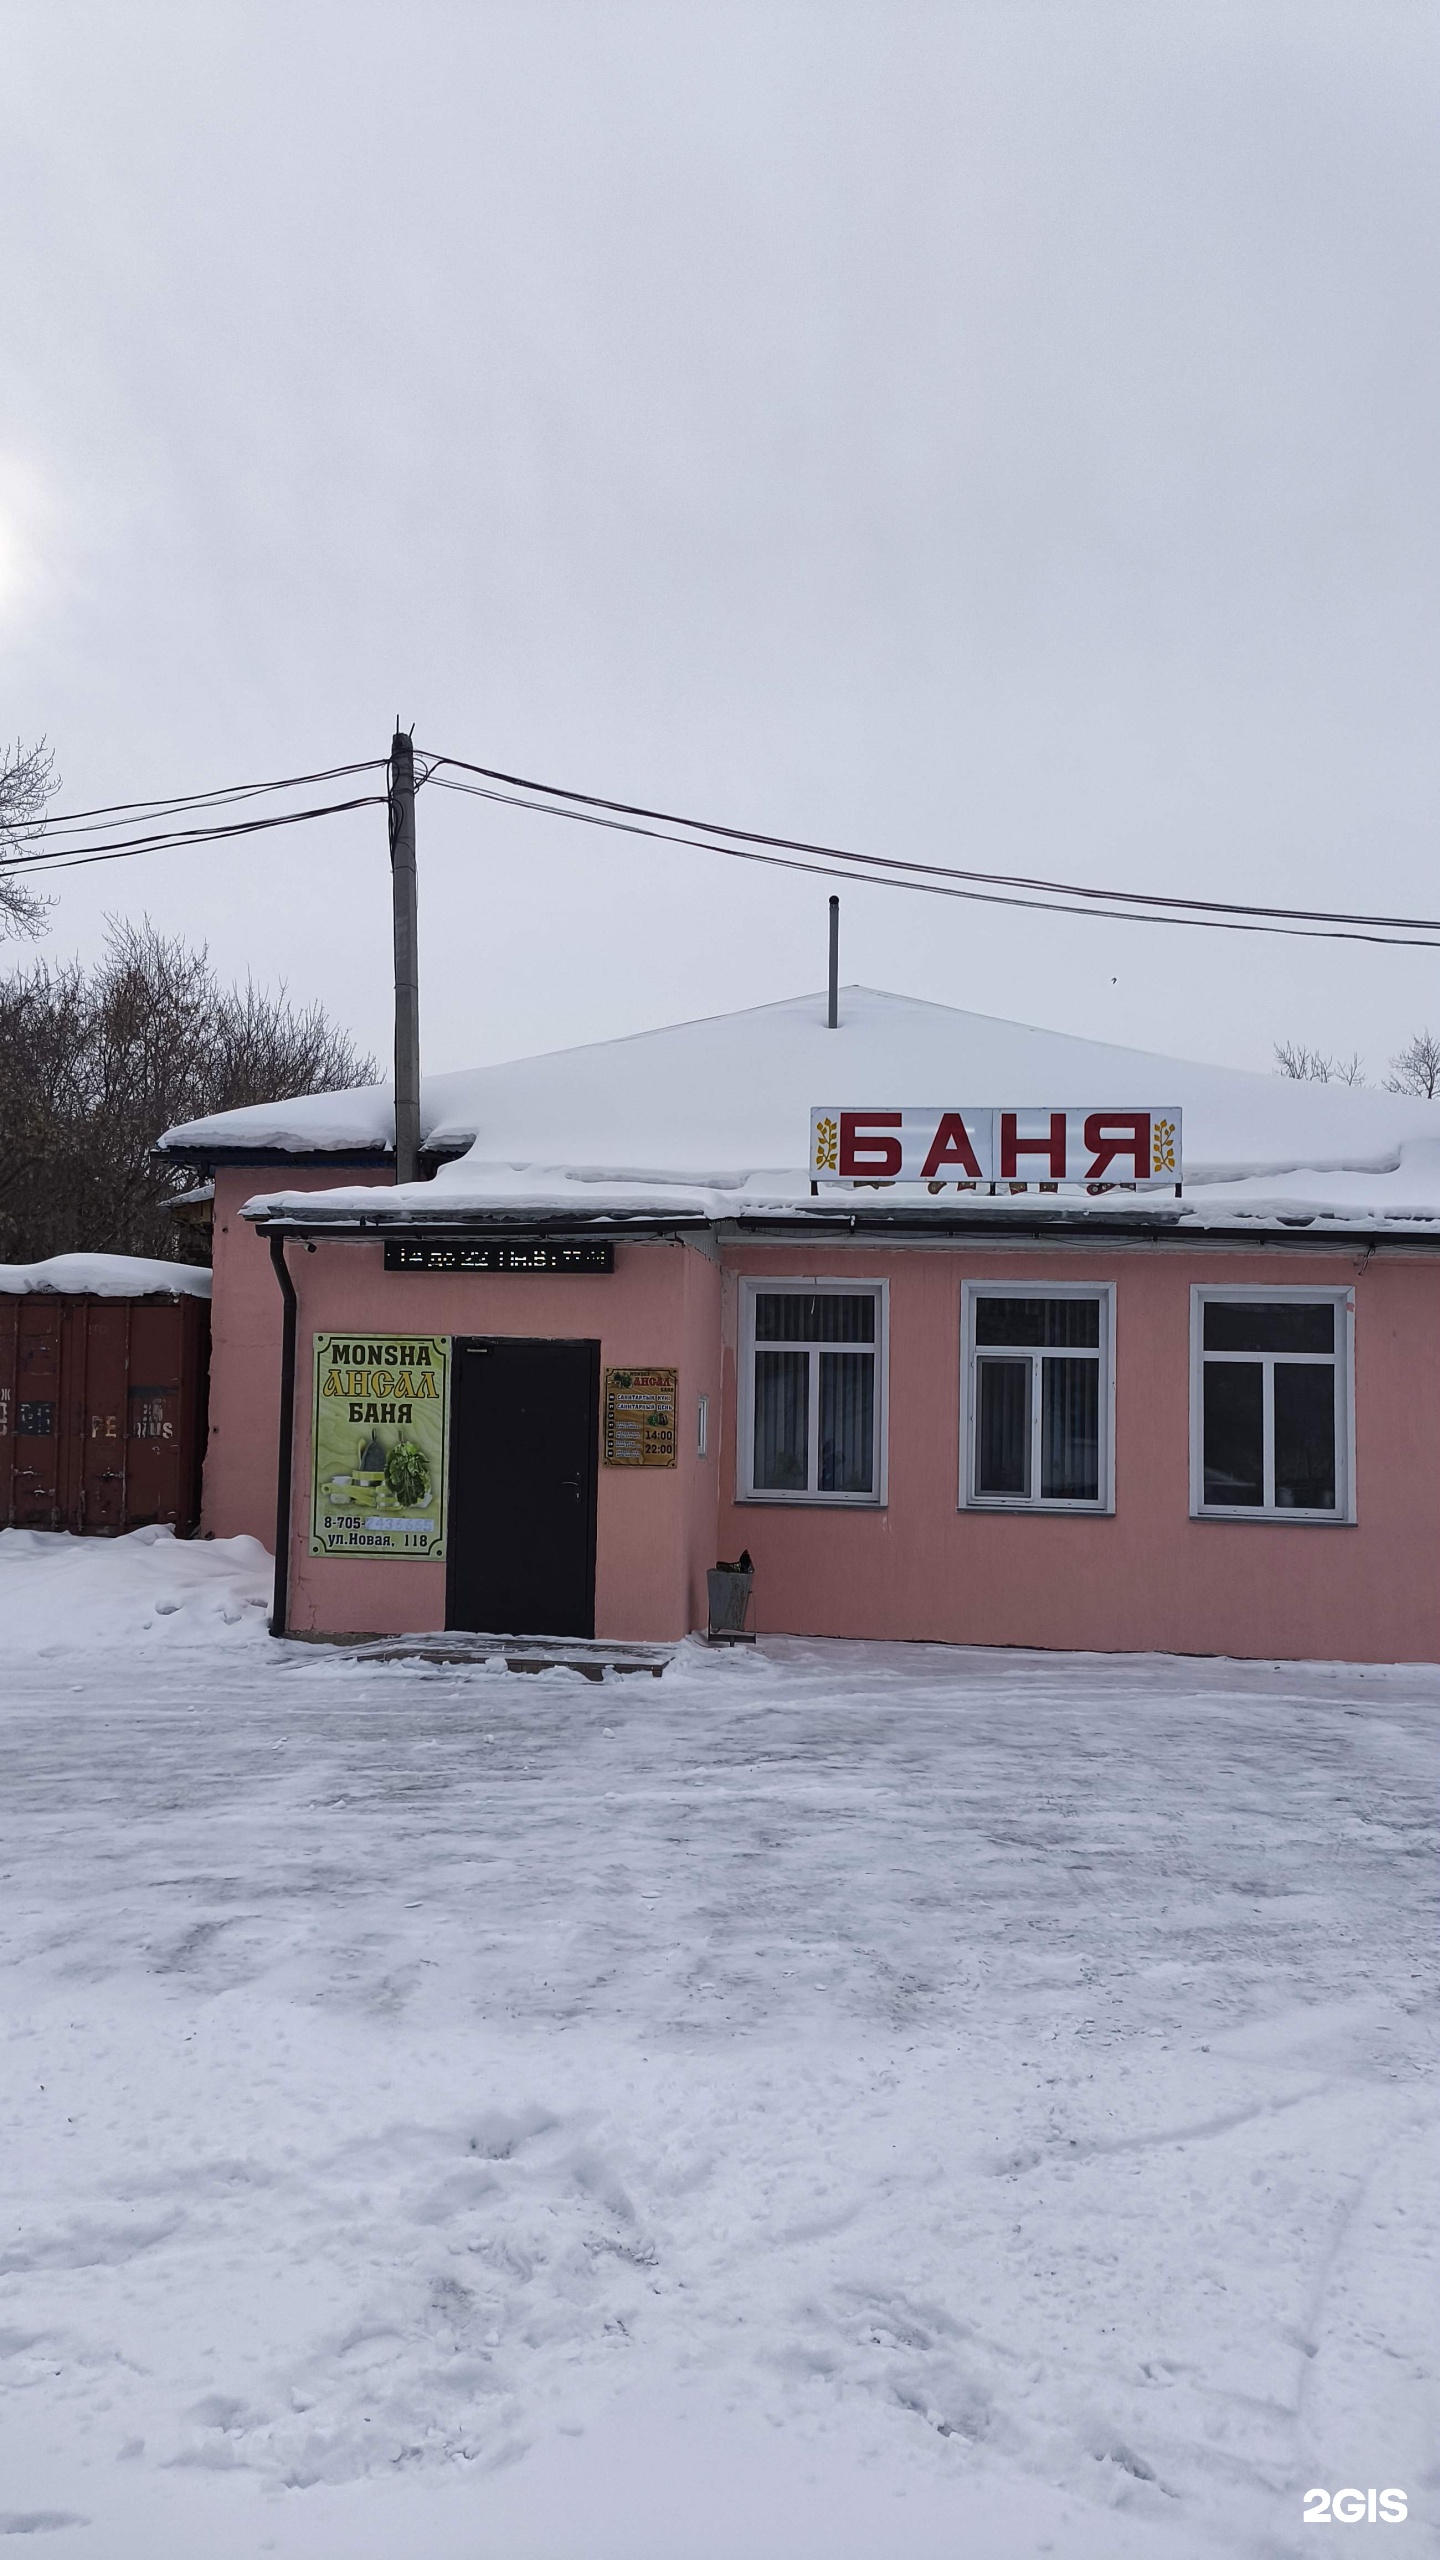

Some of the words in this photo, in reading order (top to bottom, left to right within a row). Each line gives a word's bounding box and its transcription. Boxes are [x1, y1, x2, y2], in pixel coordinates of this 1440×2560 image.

[838, 1112, 1152, 1179] БАНЯ
[331, 1344, 432, 1366] MONSHA
[322, 1369, 440, 1399] АНСАЛ
[348, 1403, 413, 1424] БАНЯ
[645, 1430, 673, 1440] 14:00
[645, 1444, 673, 1454] 22:00
[404, 1534, 428, 1547] 118
